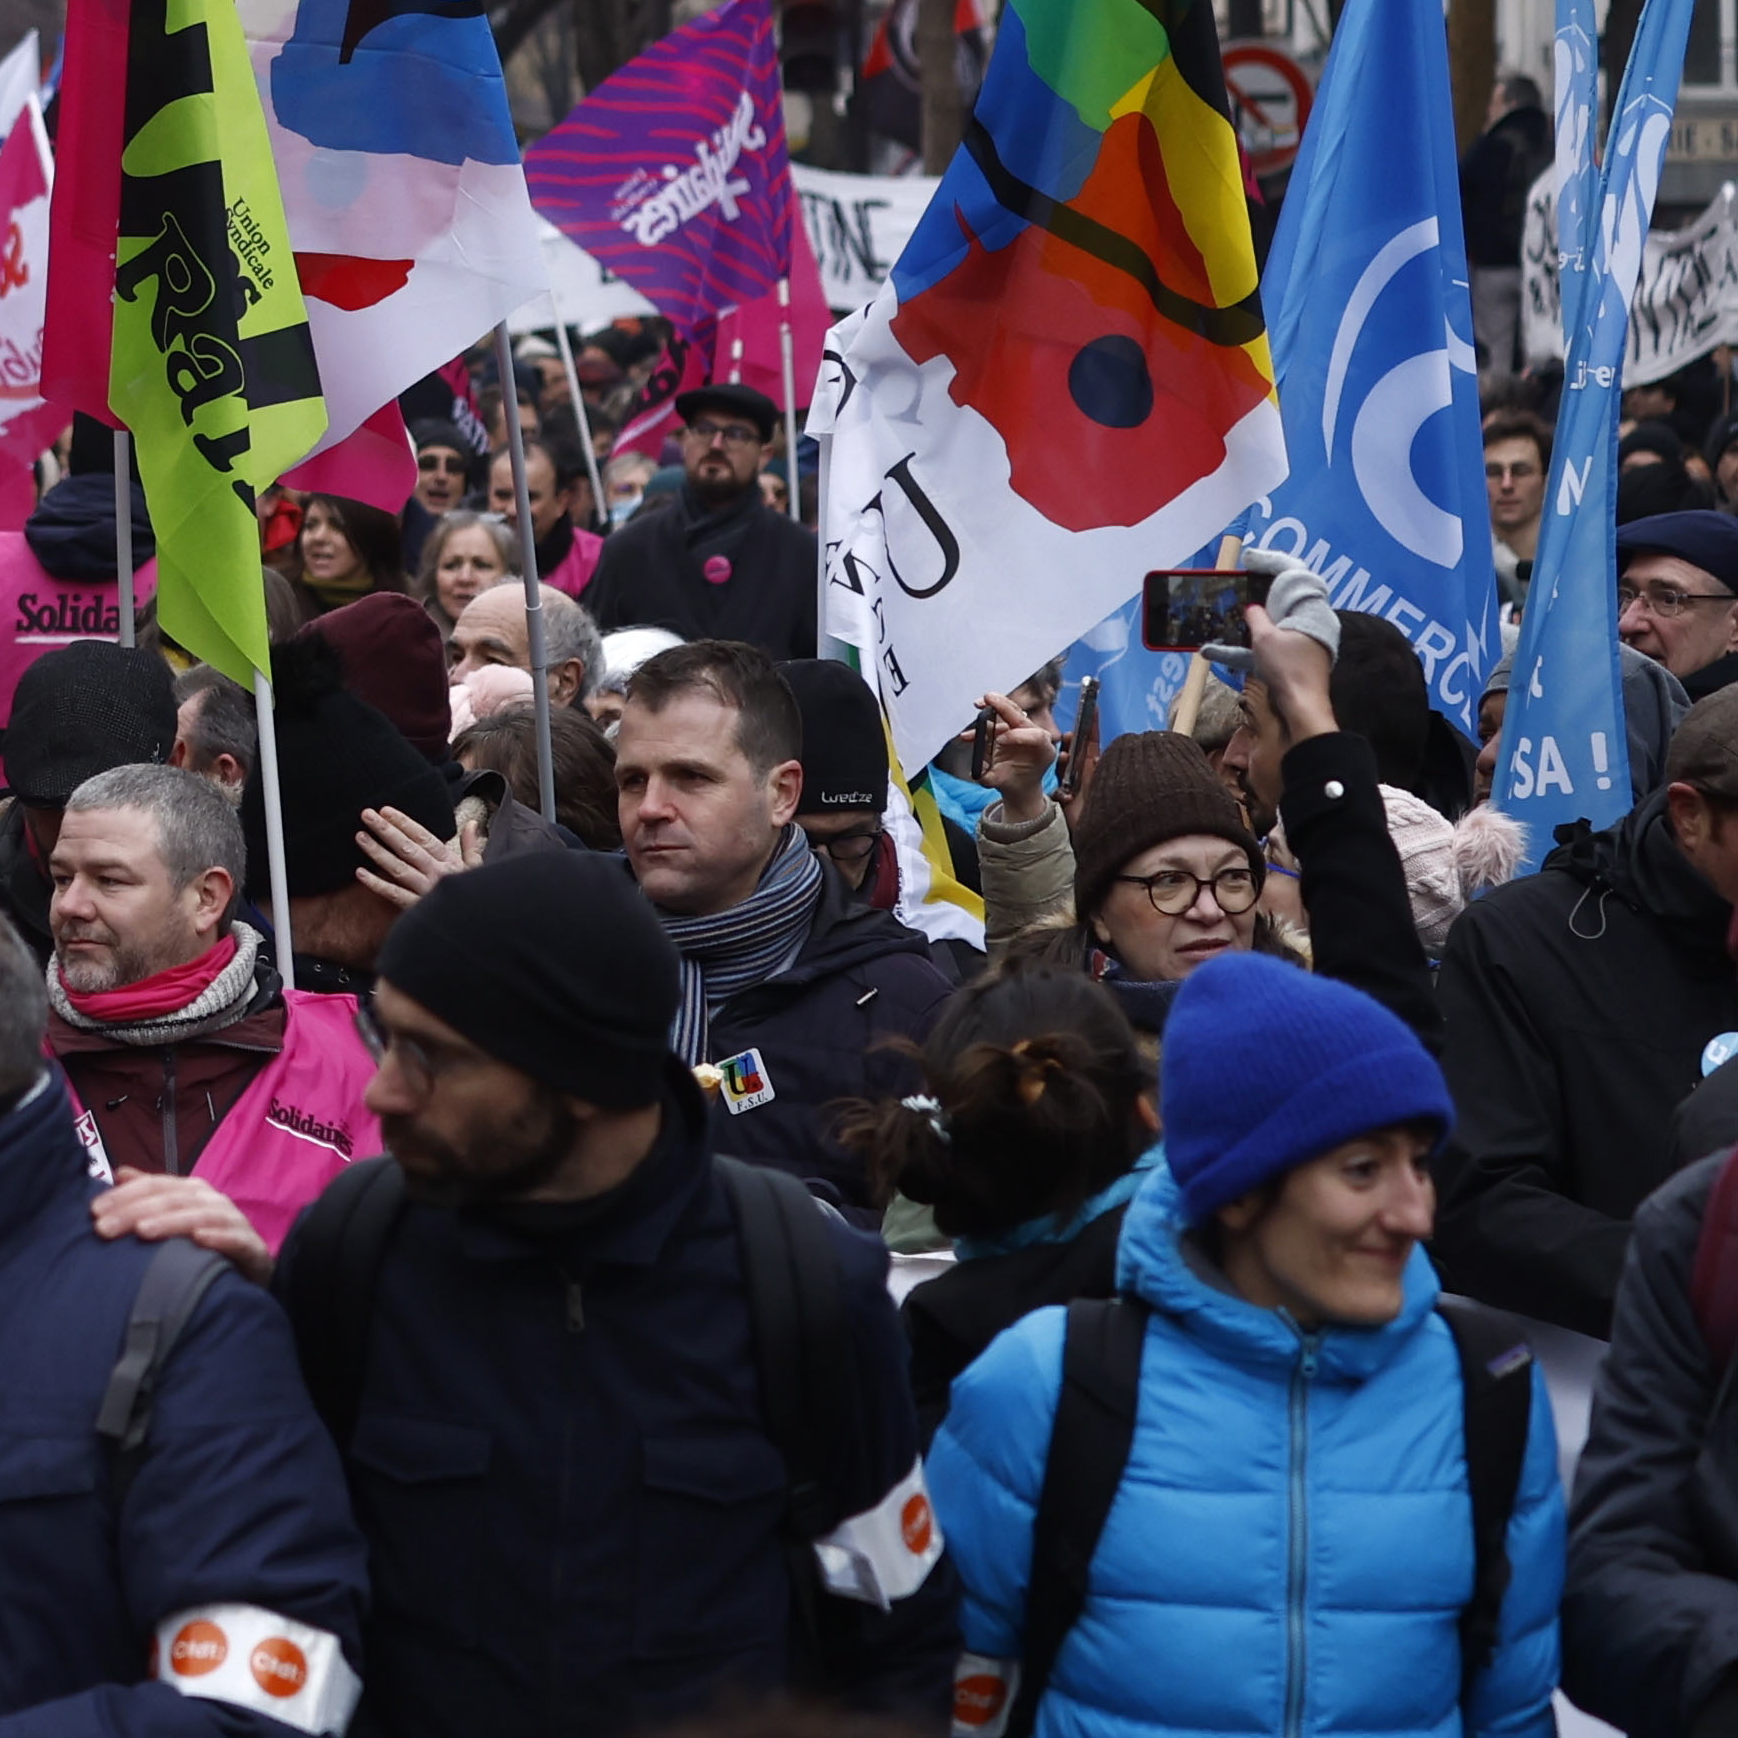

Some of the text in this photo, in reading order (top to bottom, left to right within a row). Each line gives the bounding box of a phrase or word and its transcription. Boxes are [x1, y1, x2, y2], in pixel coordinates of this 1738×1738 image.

[224, 206, 275, 290] Syndicale
[230, 195, 272, 256] Union
[736, 1091, 769, 1112] F.S.U.
